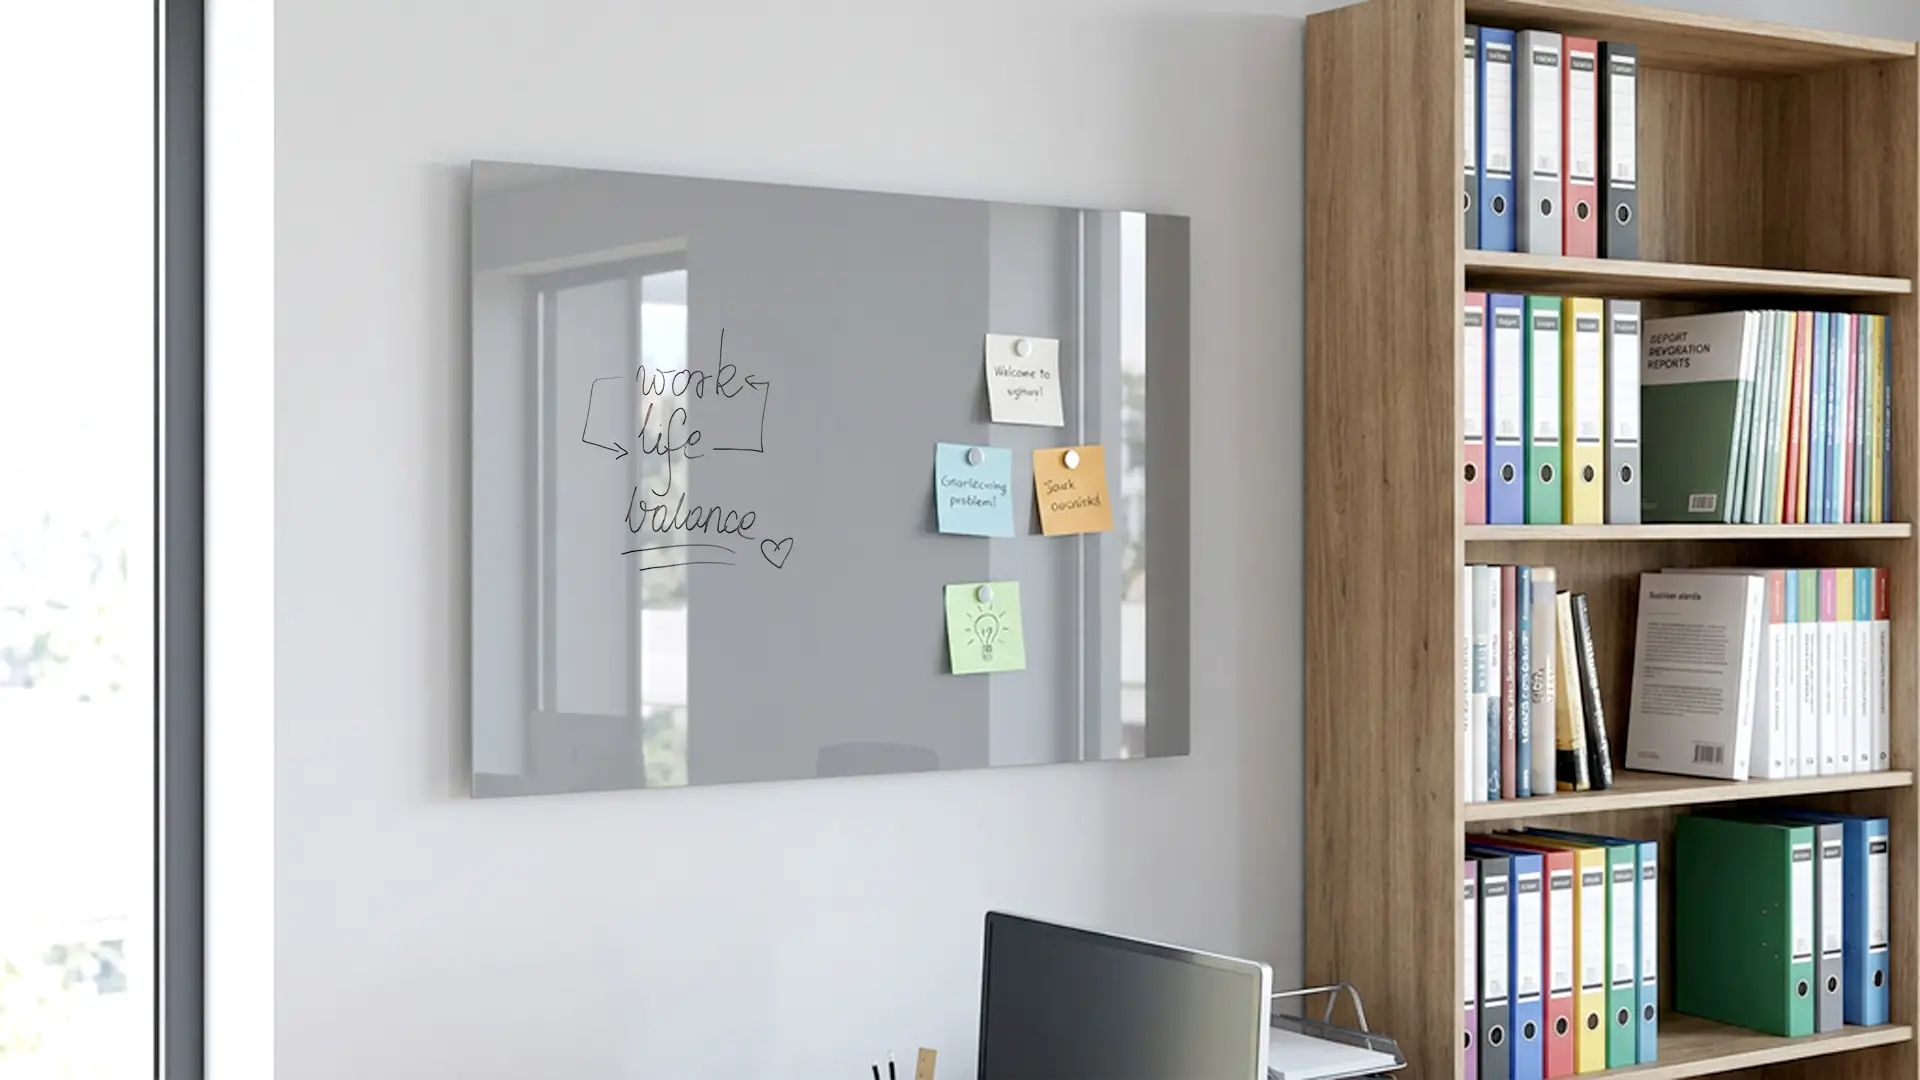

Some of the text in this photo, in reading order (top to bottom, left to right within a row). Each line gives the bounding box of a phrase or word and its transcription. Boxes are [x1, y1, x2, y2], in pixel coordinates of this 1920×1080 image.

[636, 328, 743, 398] work
[638, 403, 705, 497] life
[625, 486, 756, 540] balance
